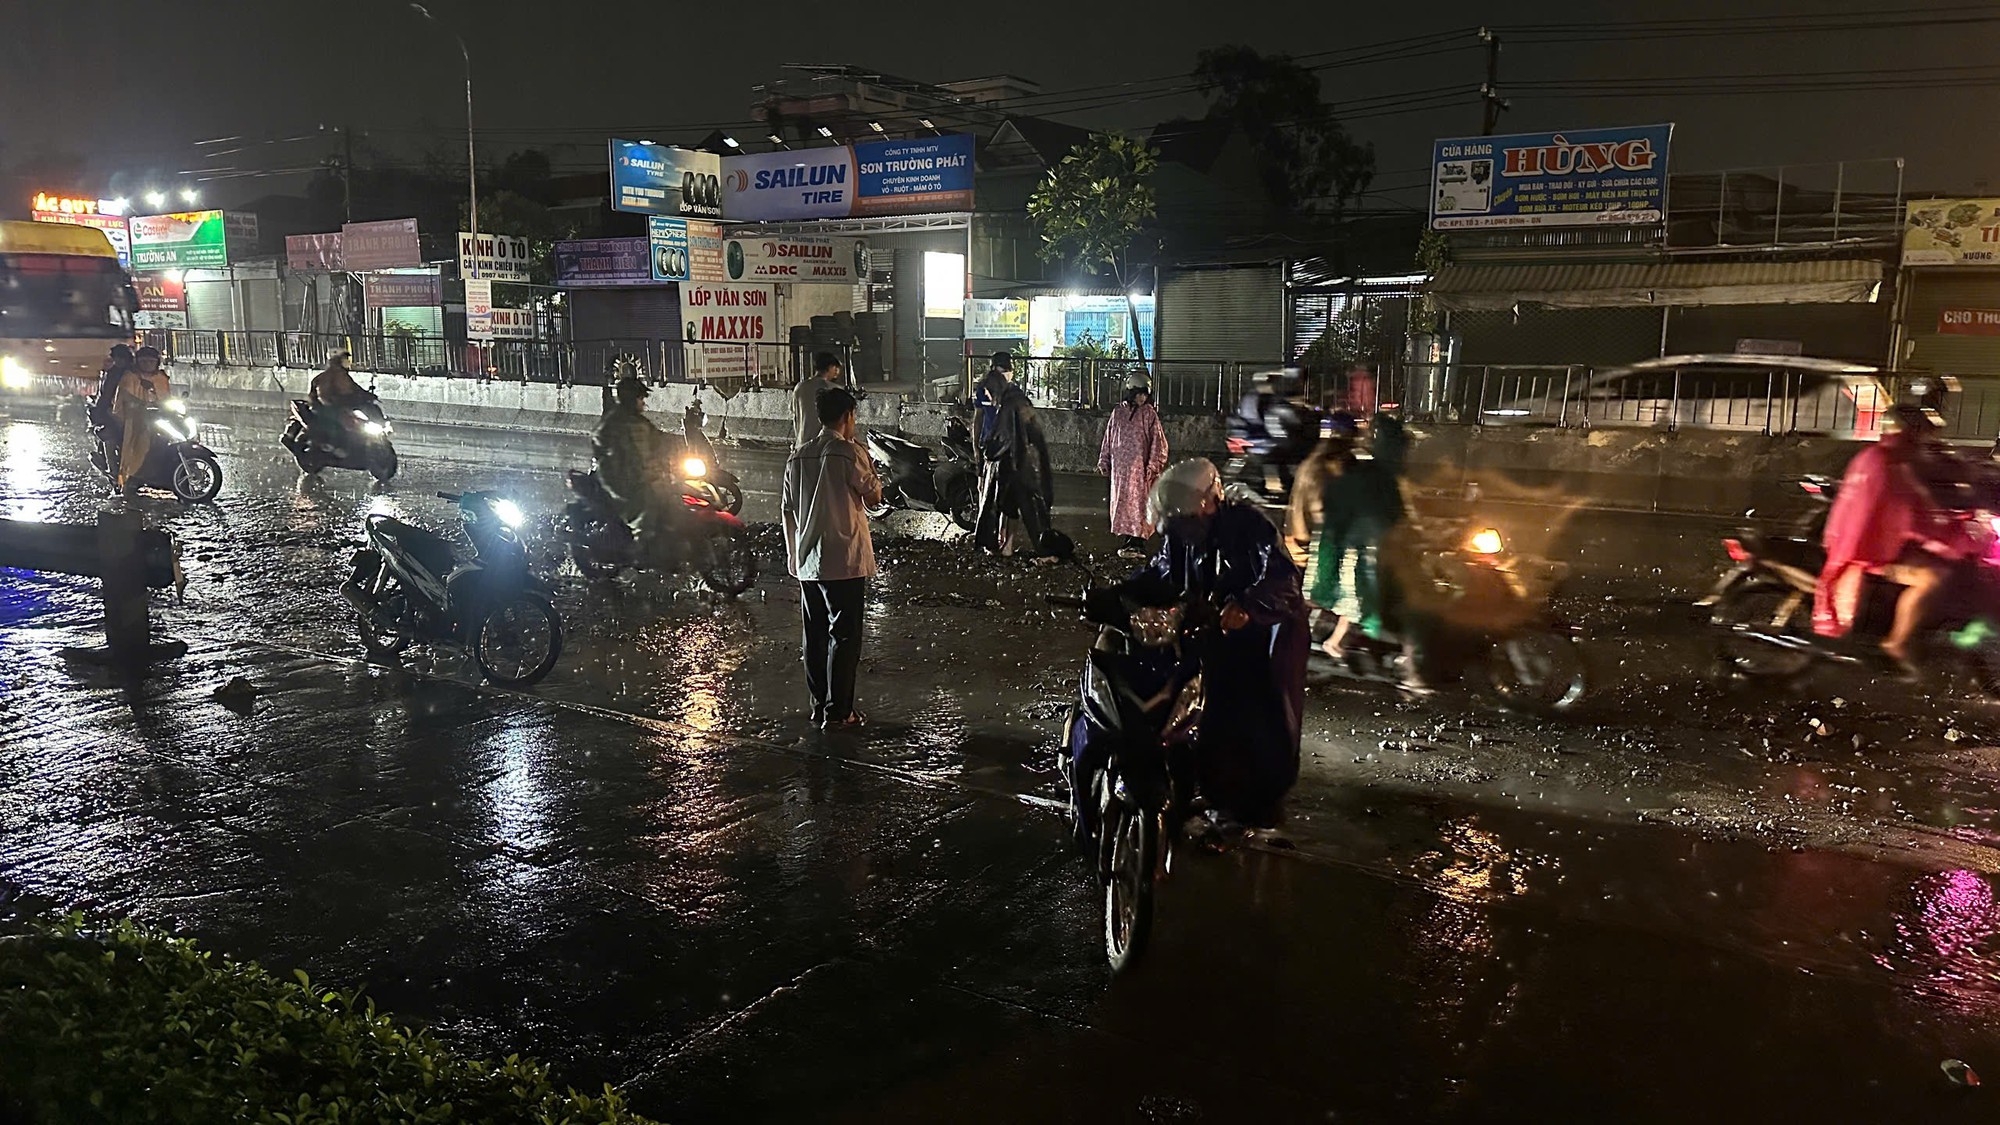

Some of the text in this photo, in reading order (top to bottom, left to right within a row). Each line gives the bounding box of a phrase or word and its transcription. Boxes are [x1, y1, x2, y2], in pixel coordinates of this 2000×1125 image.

[884, 148, 901, 156] CÔNG
[910, 147, 925, 155] TNHH
[1442, 143, 1492, 157] CỬA HÀNG
[1501, 134, 1656, 177] HÙNG
[630, 158, 664, 171] SAILUN
[860, 153, 967, 174] SƠN TRƯỜNG PHÁT
[754, 164, 847, 190] SAILUN
[920, 174, 941, 182] DOANH
[801, 190, 844, 205] TIRE
[462, 237, 526, 260] KNH Ô TÔ
[777, 244, 832, 258] SAILUN
[136, 249, 164, 263] TRƯỜNG
[166, 251, 177, 262] AN
[769, 265, 797, 275] DRC
[812, 266, 847, 276] MAXXIS
[688, 286, 767, 306] LỐP VĂN SƠN
[491, 309, 532, 326] KÍNH Ô TÔ
[1943, 310, 1972, 324] CHO
[701, 316, 764, 340] MAXXIS
